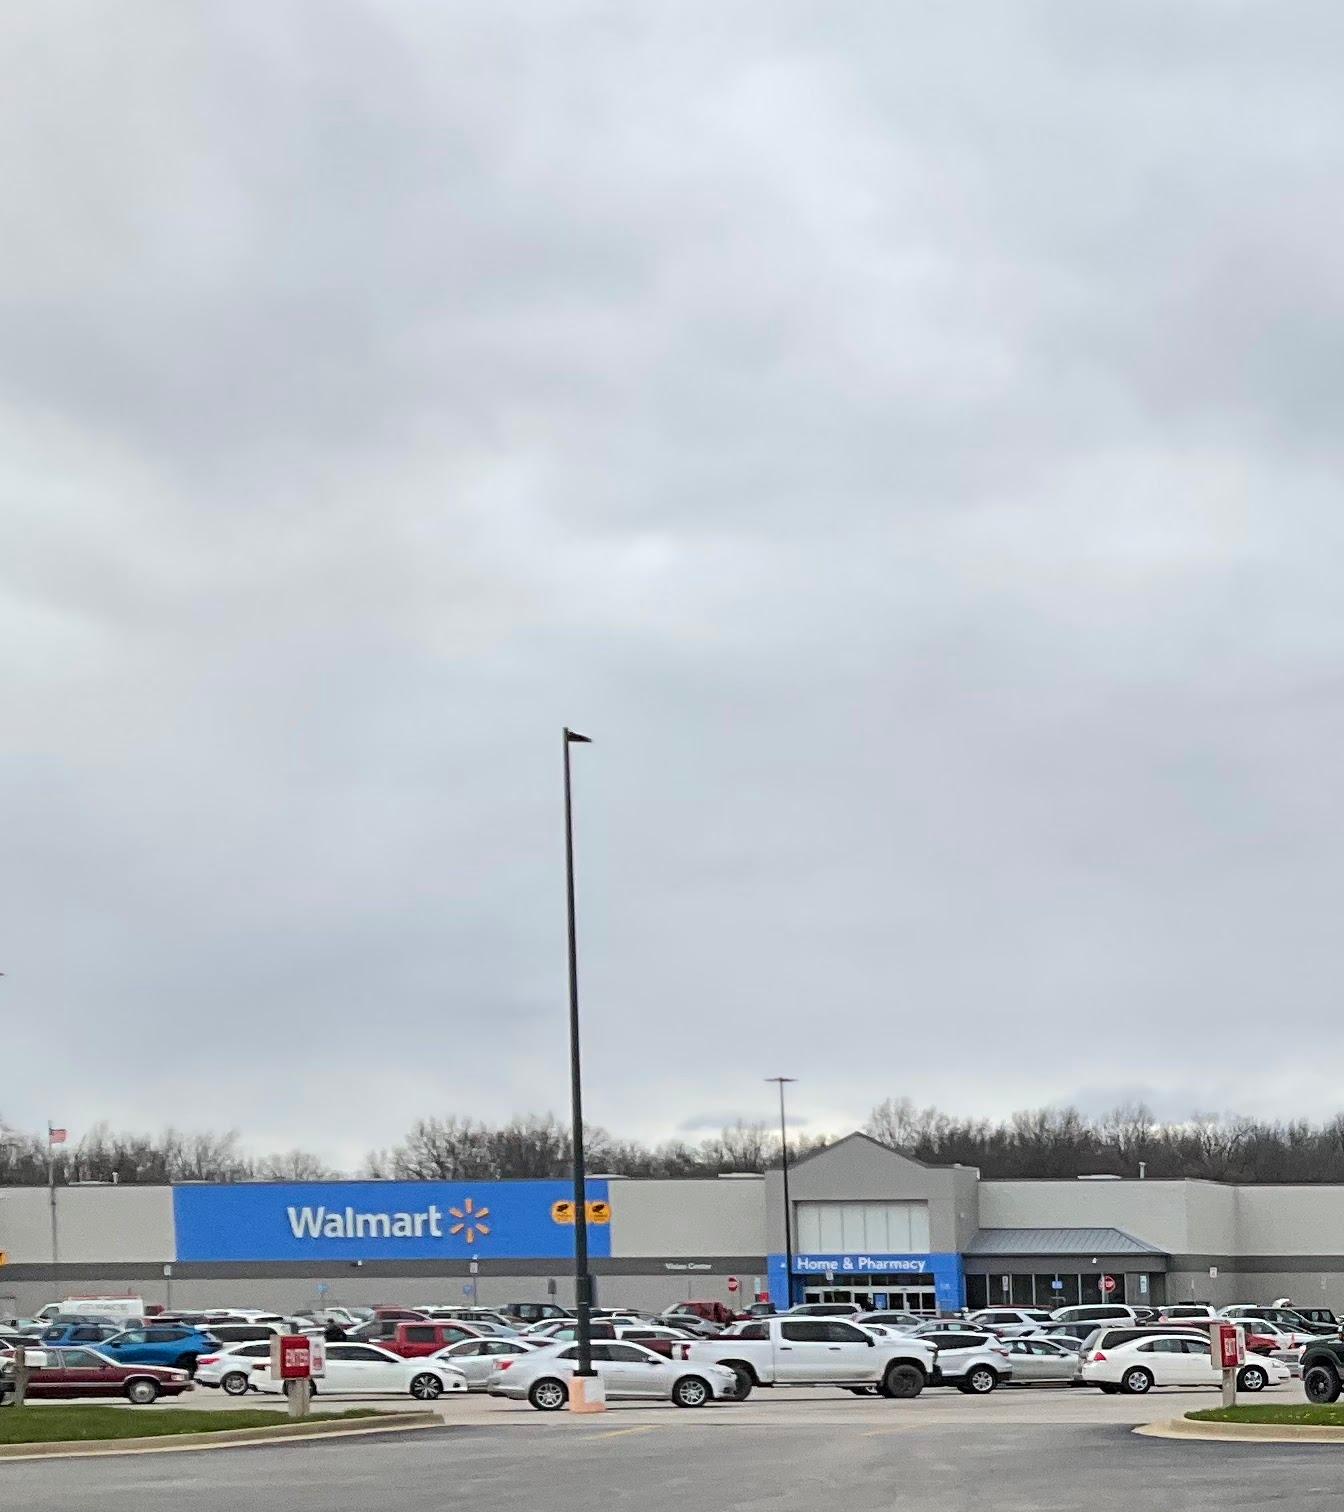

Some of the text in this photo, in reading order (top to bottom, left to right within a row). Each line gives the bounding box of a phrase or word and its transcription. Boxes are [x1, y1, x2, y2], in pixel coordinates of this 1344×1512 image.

[286, 1205, 443, 1239] Walmart
[797, 1256, 926, 1273] Home & Pharmacy
